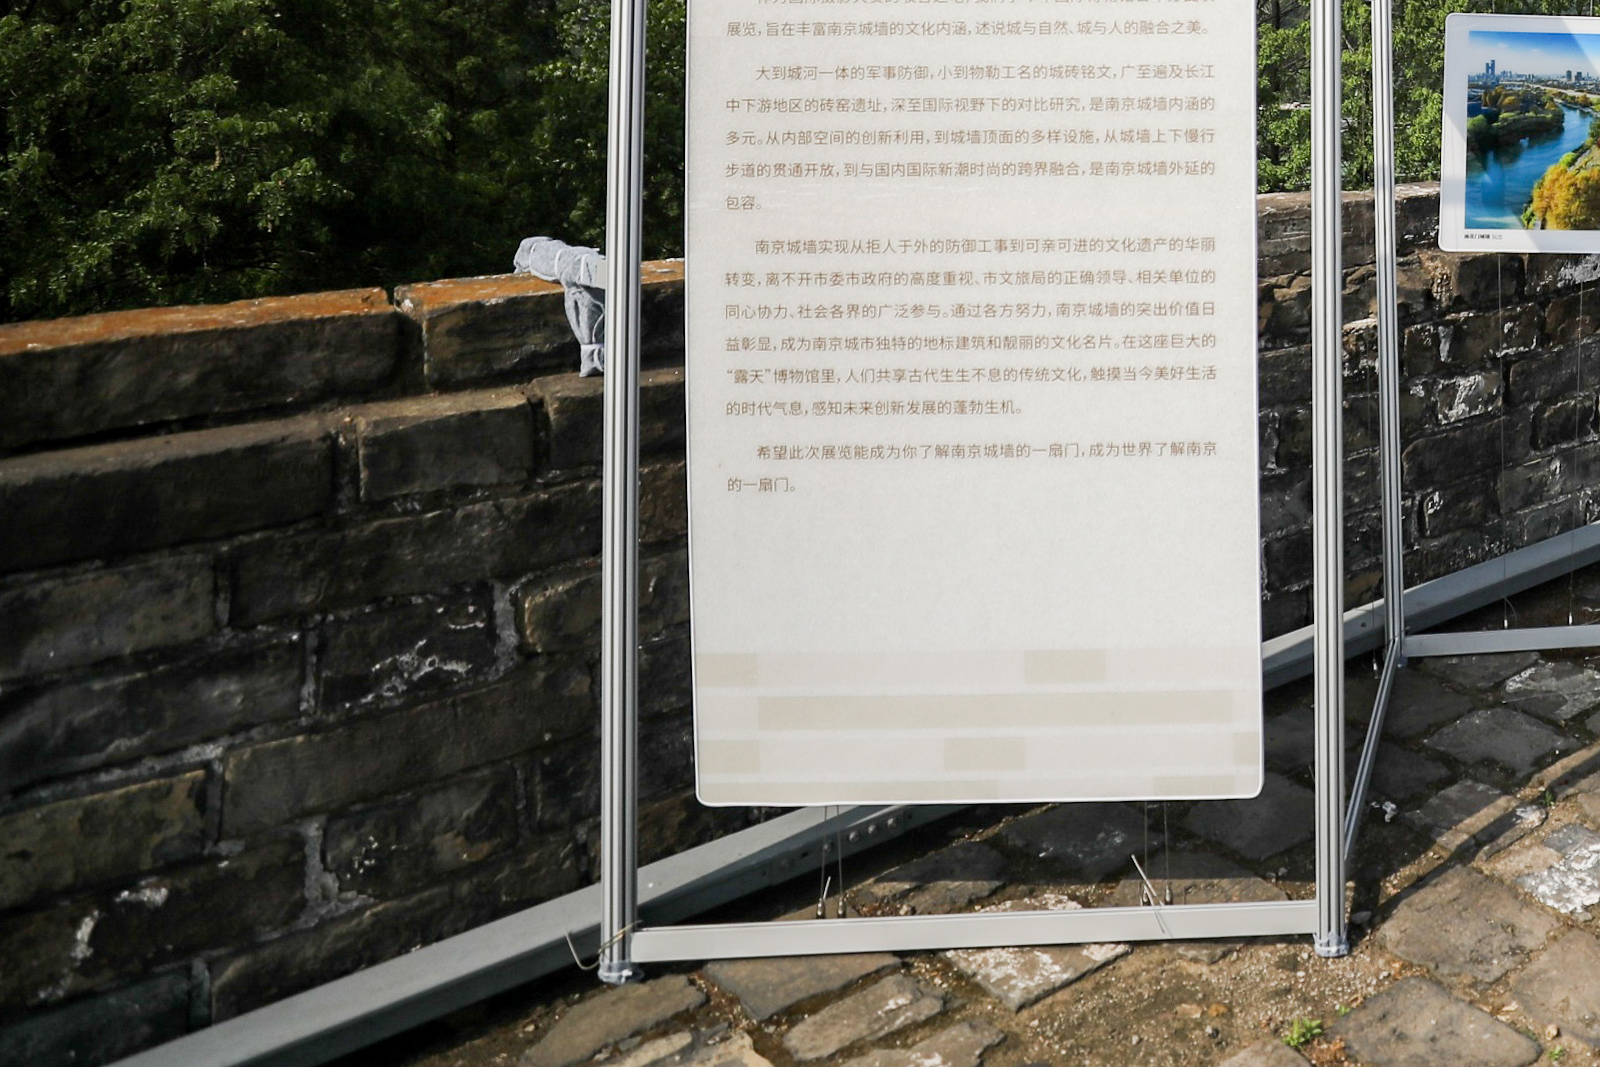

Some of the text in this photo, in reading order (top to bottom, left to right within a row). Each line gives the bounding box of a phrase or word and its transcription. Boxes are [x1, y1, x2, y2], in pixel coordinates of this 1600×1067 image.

[725, 194, 763, 211] 包容。
[727, 476, 797, 493] 的一扇门。
